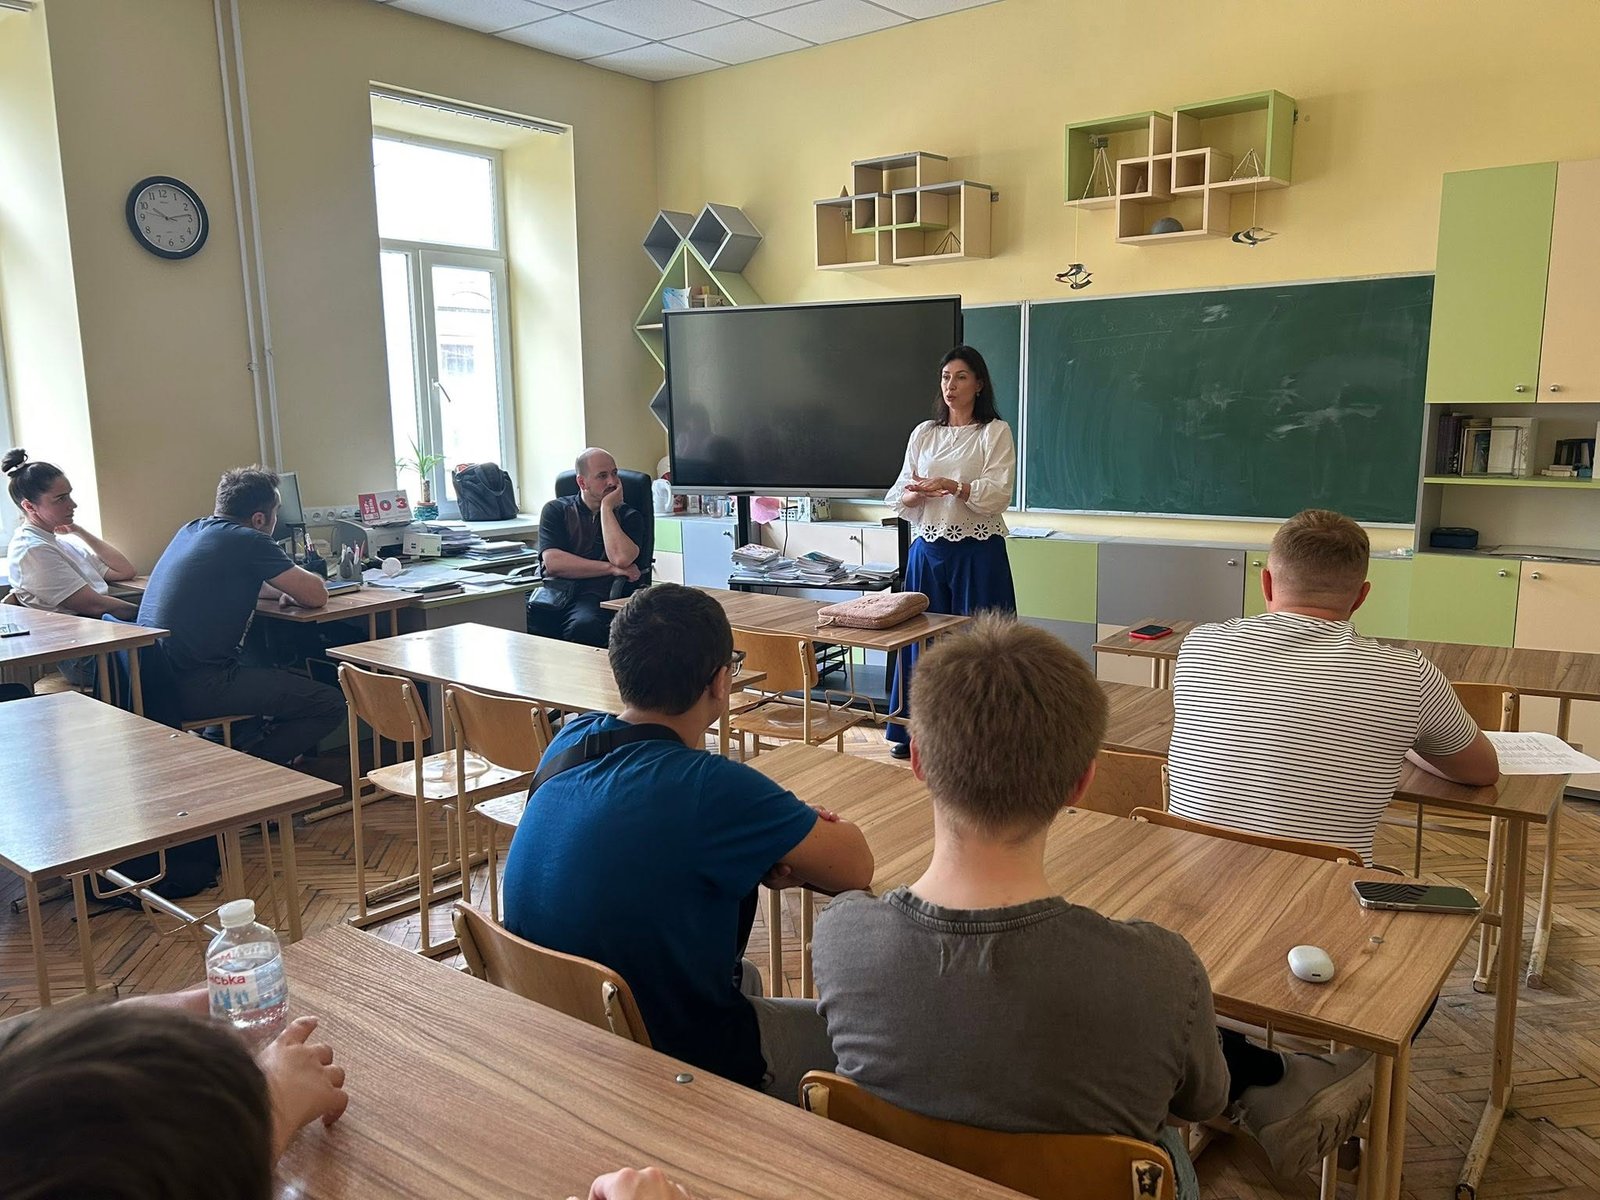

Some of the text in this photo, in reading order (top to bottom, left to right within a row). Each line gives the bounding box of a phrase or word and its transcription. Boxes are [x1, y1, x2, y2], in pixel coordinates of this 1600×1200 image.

[149, 192, 155, 200] 11
[158, 190, 168, 198] 12
[140, 201, 148, 210] 10
[183, 202, 188, 211] 2
[140, 213, 146, 221] 9
[187, 214, 193, 223] 3
[145, 226, 151, 234] 8
[187, 227, 192, 235] 4
[169, 238, 174, 246] 6
[180, 235, 185, 243] 5
